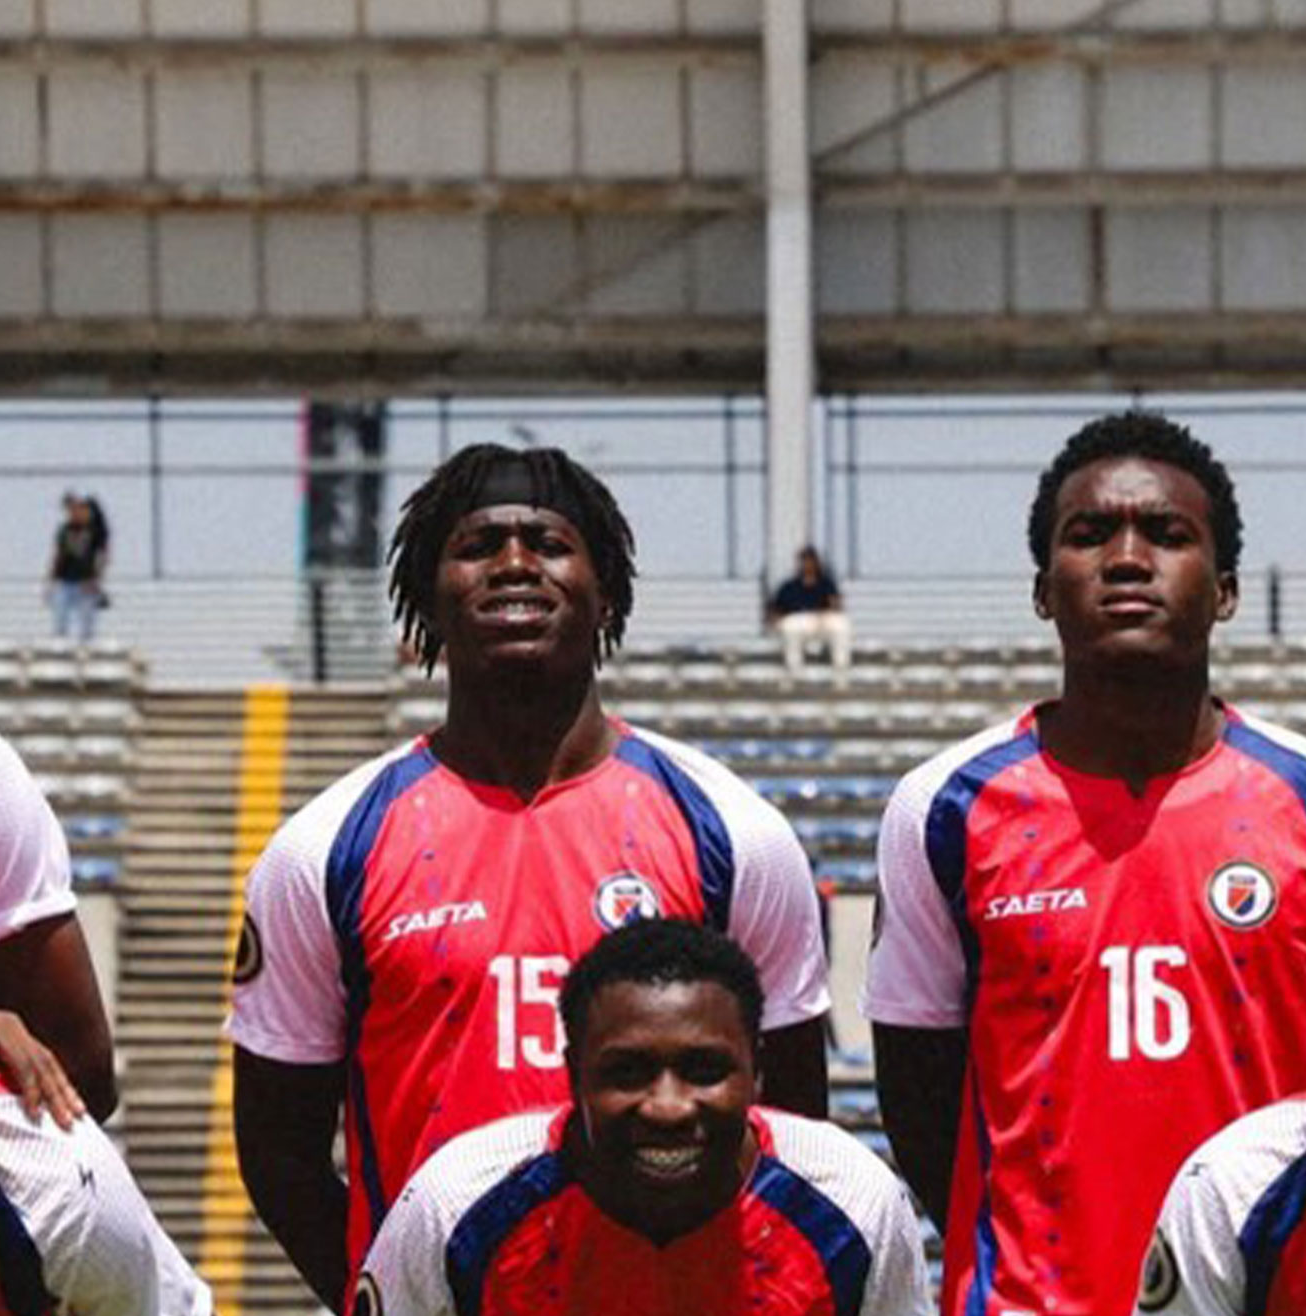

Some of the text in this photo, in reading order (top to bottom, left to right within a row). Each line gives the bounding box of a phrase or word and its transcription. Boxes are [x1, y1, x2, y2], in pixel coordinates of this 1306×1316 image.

[383, 900, 488, 942] SAETA
[984, 887, 1088, 920] SAETA
[488, 953, 571, 1069] 15
[1099, 945, 1191, 1061] 16
